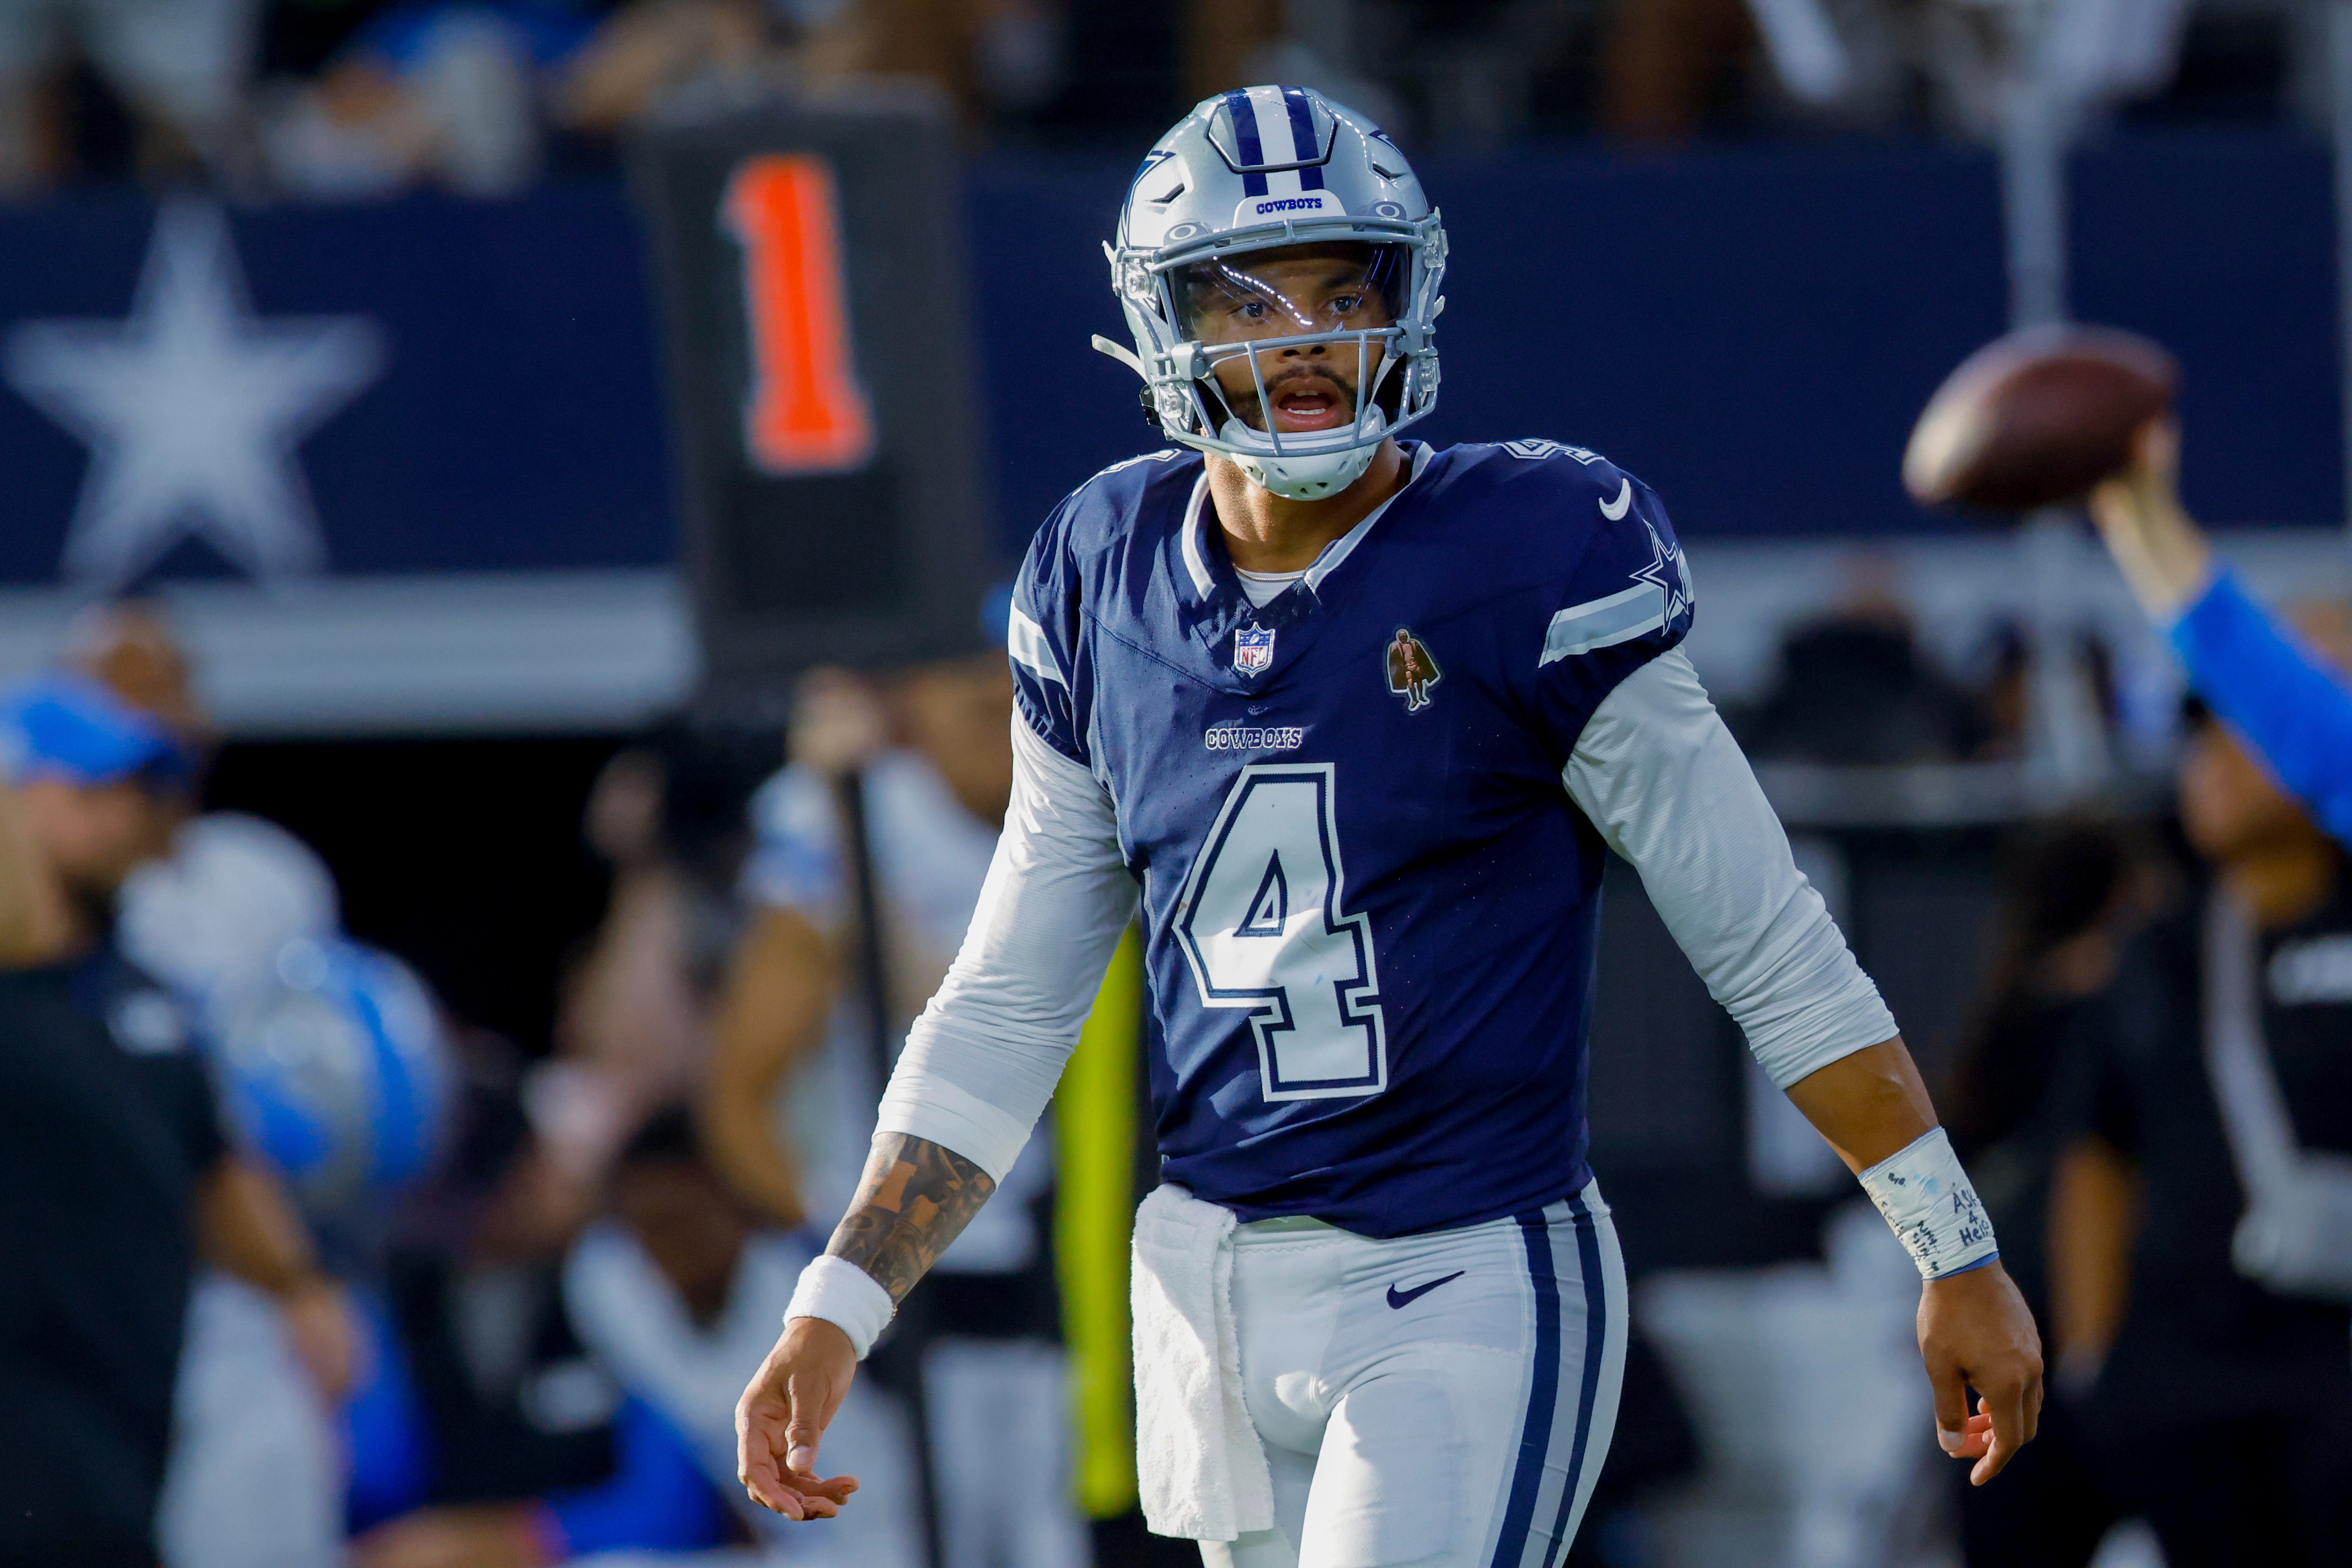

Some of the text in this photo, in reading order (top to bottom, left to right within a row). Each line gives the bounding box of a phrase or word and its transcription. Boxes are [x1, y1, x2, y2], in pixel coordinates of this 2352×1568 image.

[1256, 198, 1322, 215] COWBOYS
[717, 151, 877, 475] 1
[1240, 647, 1266, 667] NFL
[1205, 727, 1302, 750] COWBOYS
[1171, 762, 1387, 1102] 4
